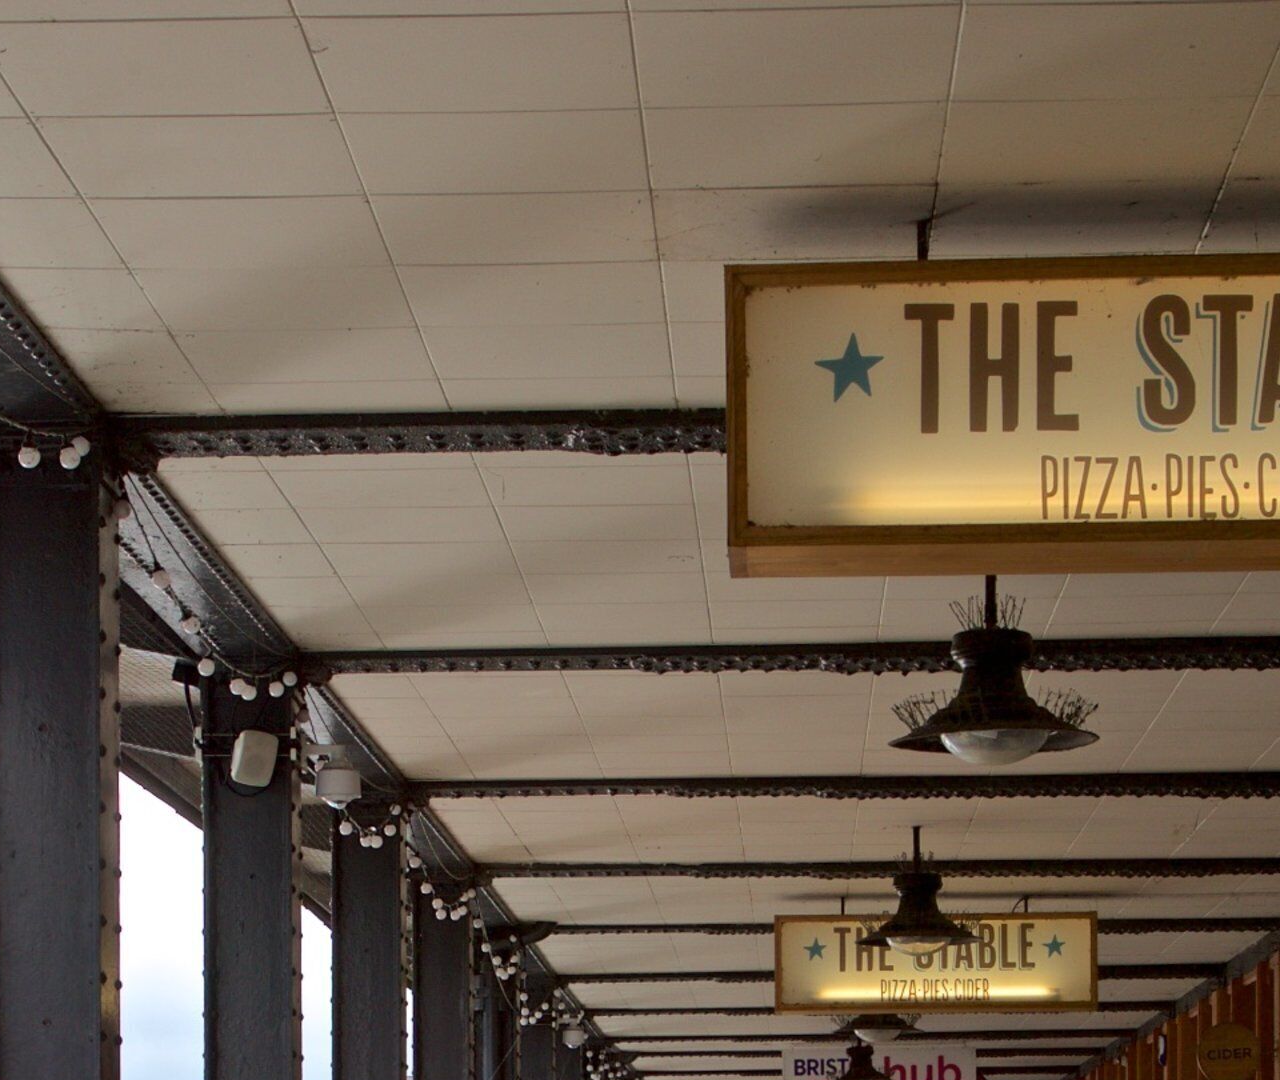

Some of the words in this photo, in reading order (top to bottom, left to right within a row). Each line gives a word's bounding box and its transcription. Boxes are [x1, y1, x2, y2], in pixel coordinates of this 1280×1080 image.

[903, 300, 1080, 434] THE
[833, 927, 894, 973] THE
[793, 1058, 850, 1077] BRIST
[1207, 1047, 1252, 1061] CIDER
